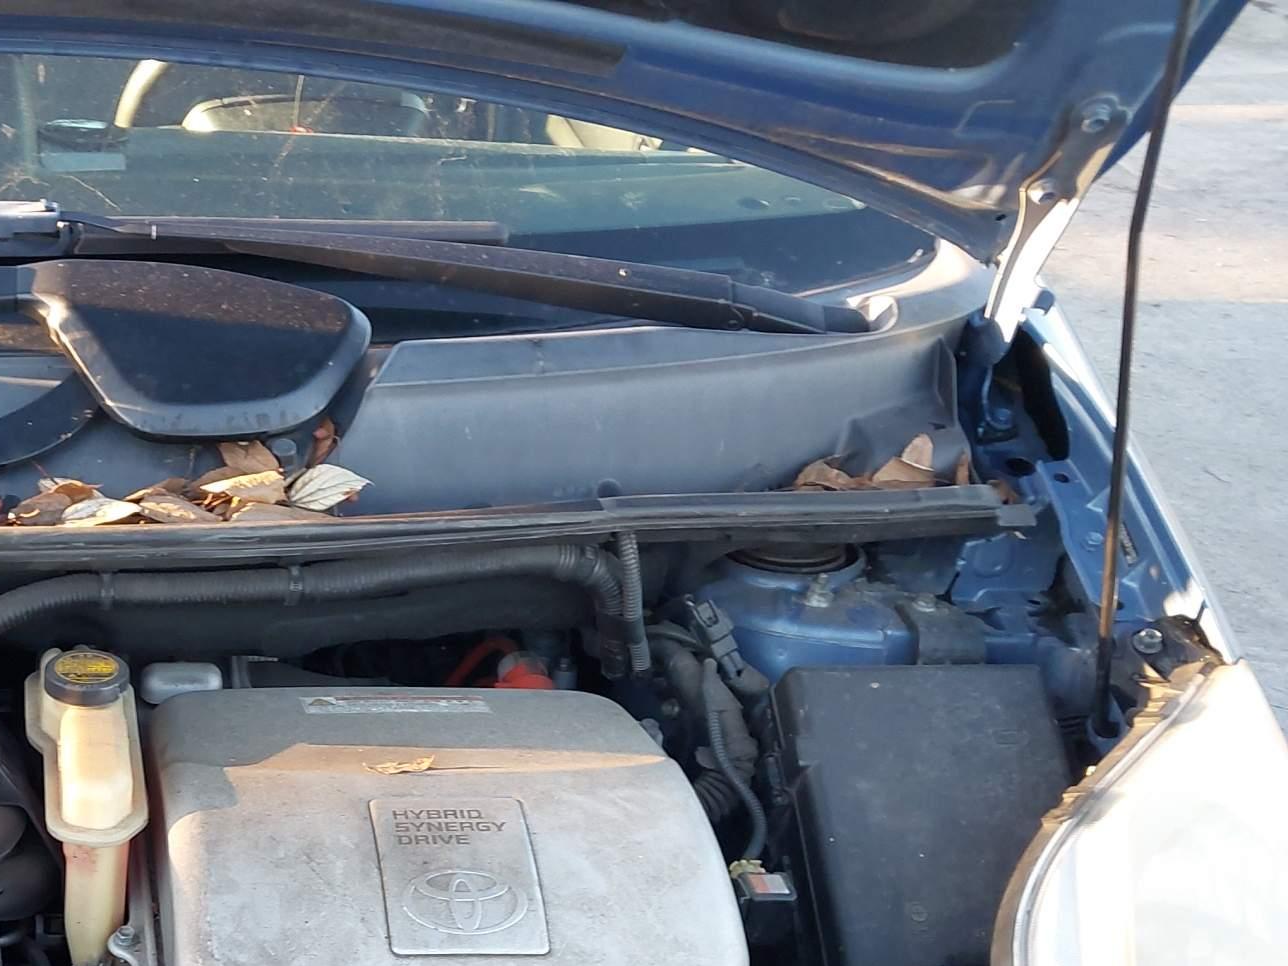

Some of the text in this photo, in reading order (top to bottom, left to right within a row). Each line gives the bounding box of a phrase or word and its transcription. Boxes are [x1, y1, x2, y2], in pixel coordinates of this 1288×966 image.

[392, 809, 483, 820] HYBRID
[395, 821, 506, 833] SYNERGY
[397, 834, 471, 845] DRIVE
